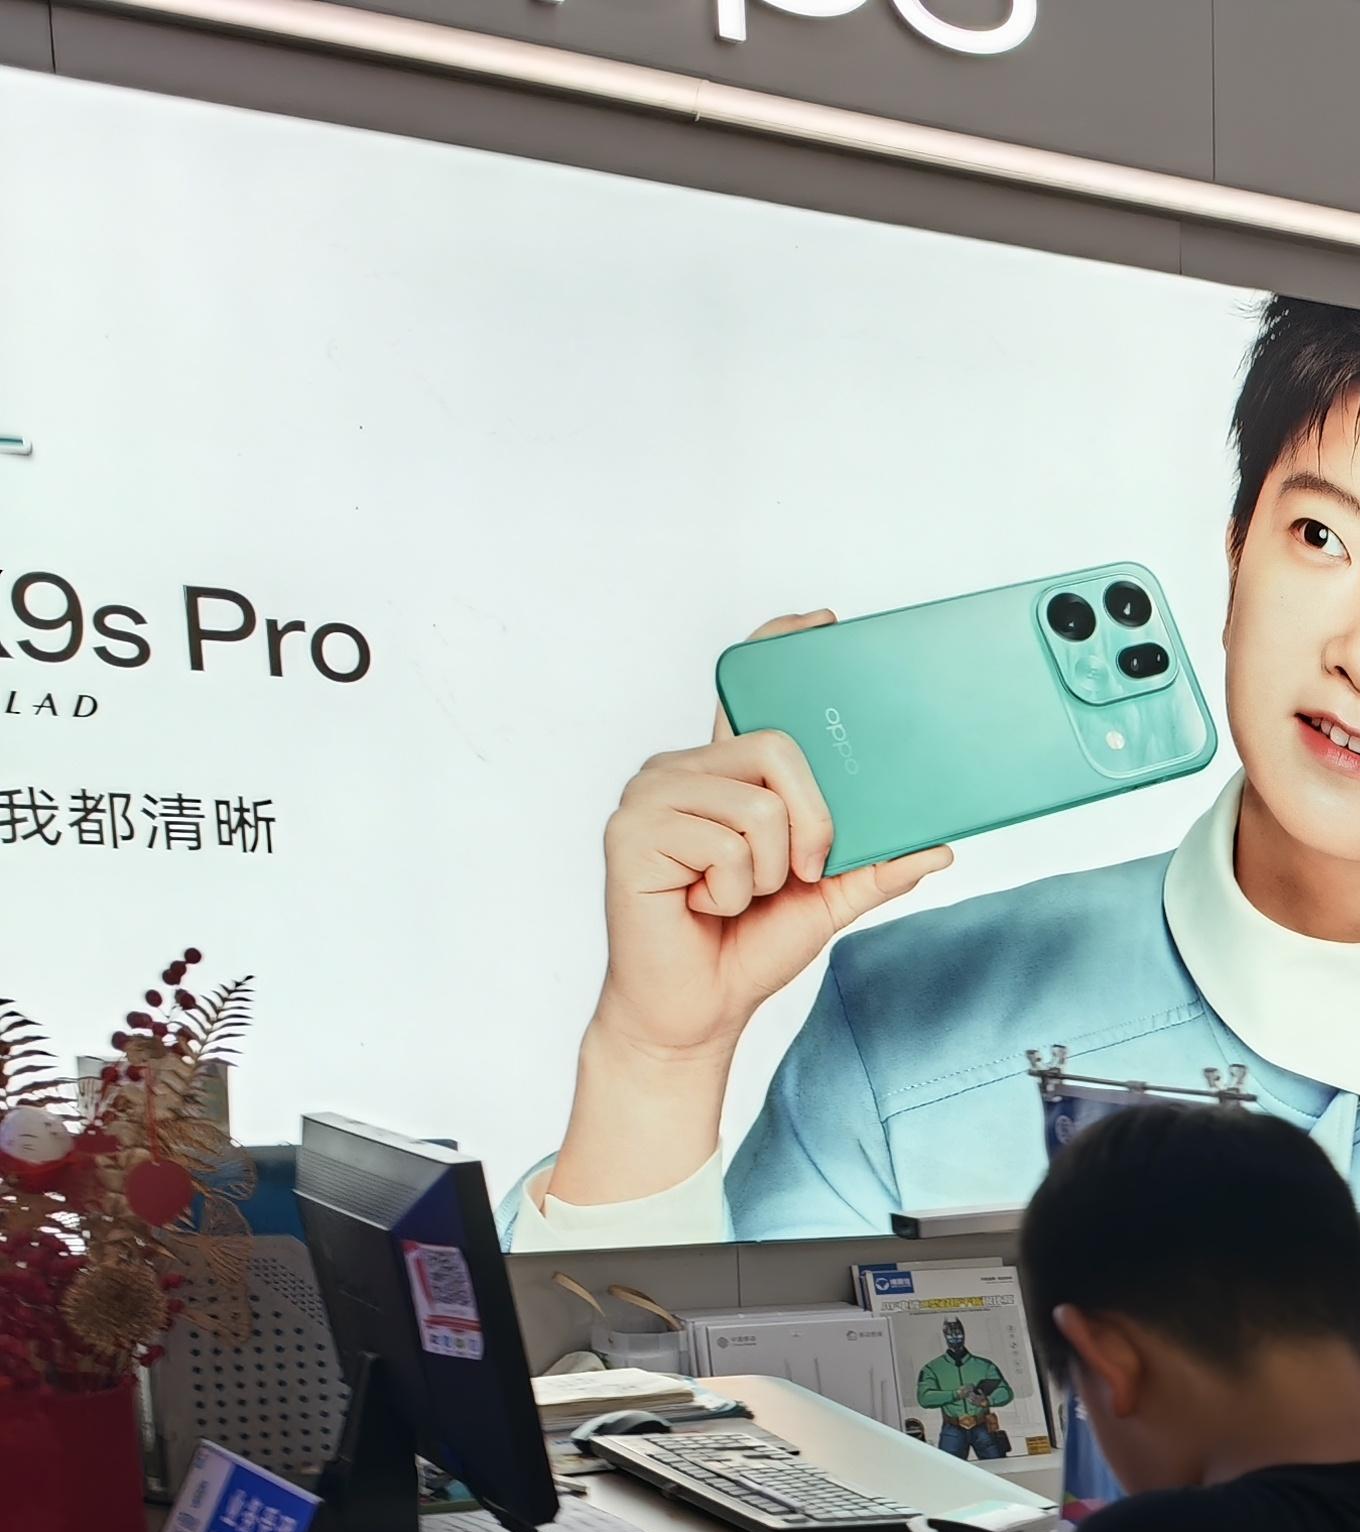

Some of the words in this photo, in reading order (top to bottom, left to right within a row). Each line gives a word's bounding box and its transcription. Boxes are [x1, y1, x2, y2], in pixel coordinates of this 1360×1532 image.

[0, 570, 151, 669] 9s
[183, 585, 372, 683] Pro
[825, 707, 859, 775] oppo
[0, 786, 276, 854] 我都清晰
